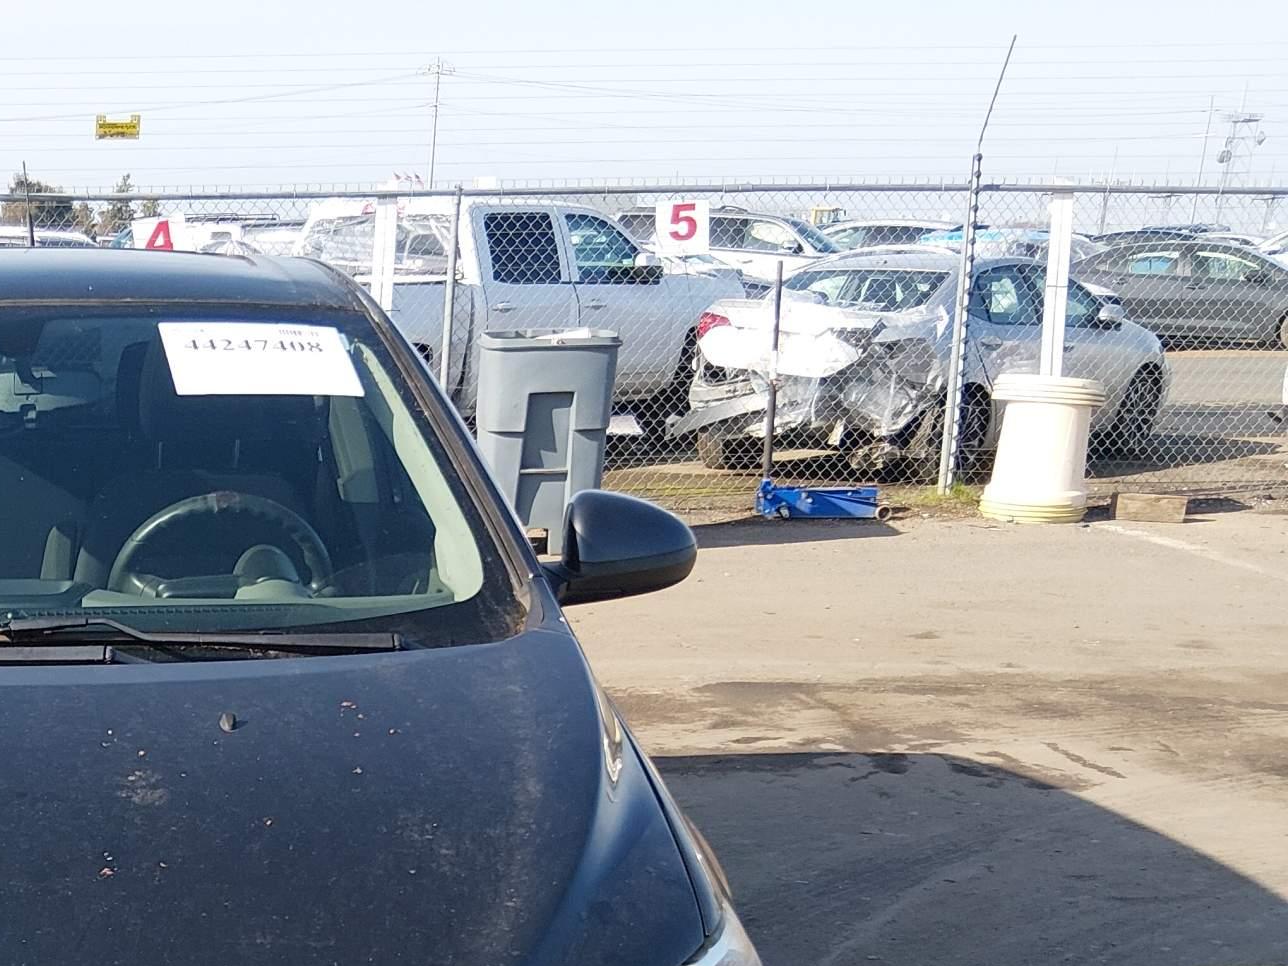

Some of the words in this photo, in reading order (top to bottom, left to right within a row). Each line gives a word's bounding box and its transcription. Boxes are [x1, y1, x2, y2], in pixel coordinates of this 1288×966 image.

[145, 220, 173, 251] 4
[669, 203, 697, 241] 5
[185, 338, 324, 353] 44247408
